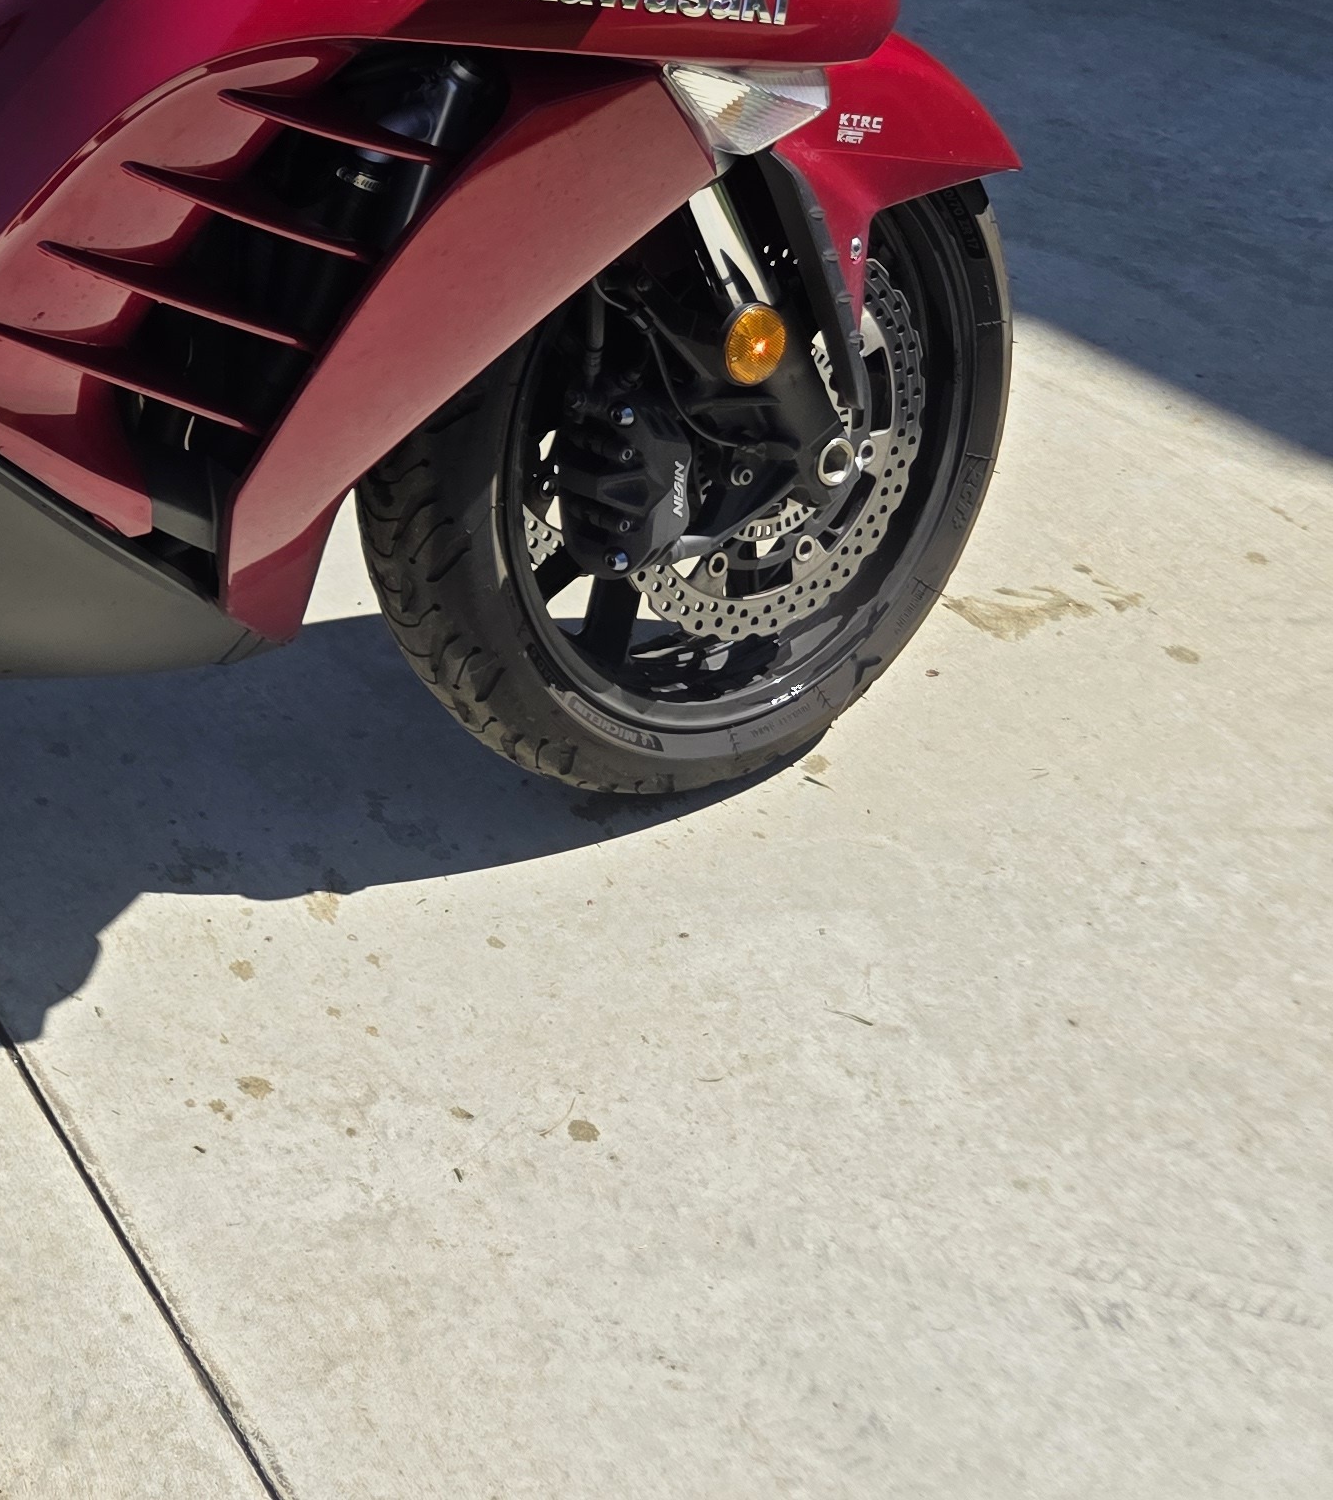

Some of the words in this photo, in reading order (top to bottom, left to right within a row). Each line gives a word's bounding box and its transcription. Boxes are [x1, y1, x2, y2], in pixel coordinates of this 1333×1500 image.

[838, 113, 884, 130] KTRC
[672, 460, 685, 518] NISSIN
[572, 699, 638, 743] MICHELIN
